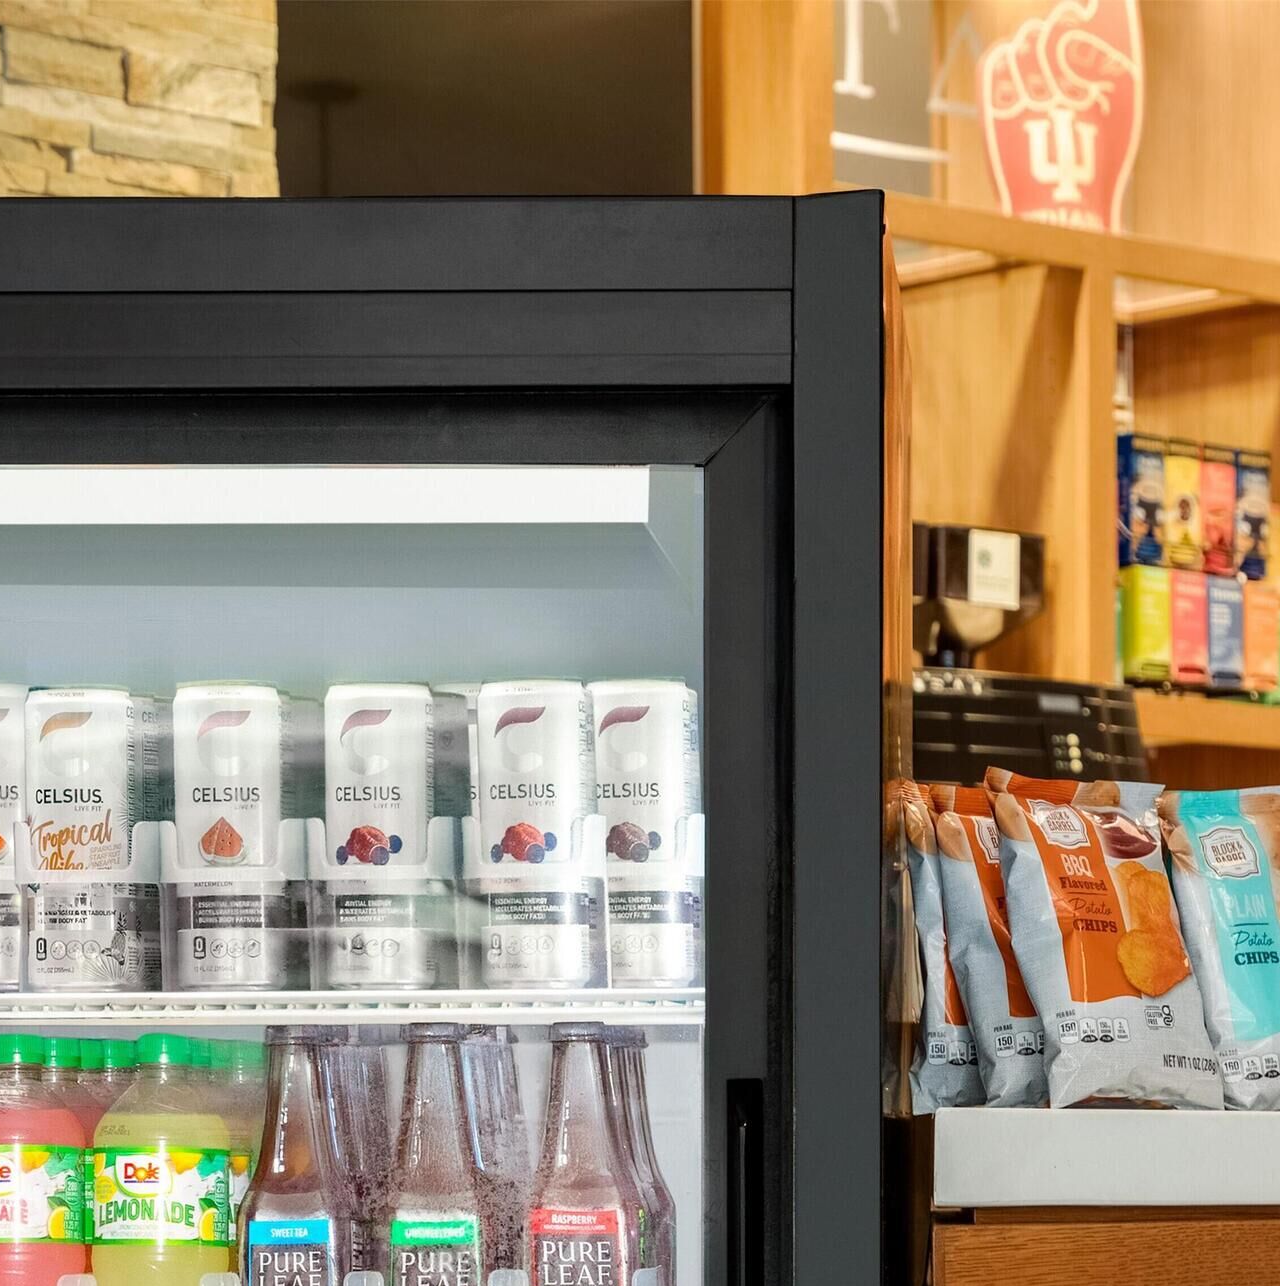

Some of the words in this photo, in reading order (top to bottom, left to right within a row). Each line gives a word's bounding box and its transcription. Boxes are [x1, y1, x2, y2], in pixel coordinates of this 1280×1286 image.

[35, 788, 104, 804] CELSIUS
[193, 787, 261, 803] CELSIUS
[336, 786, 401, 802] CELSIUS
[490, 783, 557, 800] CELSIUS
[31, 809, 112, 860] Tropical
[1060, 854, 1096, 878] BBQ
[1058, 876, 1108, 892] Flavored
[1072, 918, 1118, 934] CHIPS
[1230, 930, 1275, 948] Potato
[1234, 950, 1280, 966] CHIPS
[1060, 1021, 1077, 1033] 150
[929, 1043, 946, 1054] 150
[997, 1036, 1014, 1047] 150
[1163, 1053, 1176, 1069] NET
[1224, 1060, 1240, 1072] 160
[98, 1198, 195, 1227] LEMONADE
[551, 1214, 597, 1225] RASPBERRY
[541, 1241, 611, 1263] PURE
[258, 1252, 323, 1274] PURE
[400, 1252, 471, 1274] PURE
[543, 1264, 610, 1286] LEAF
